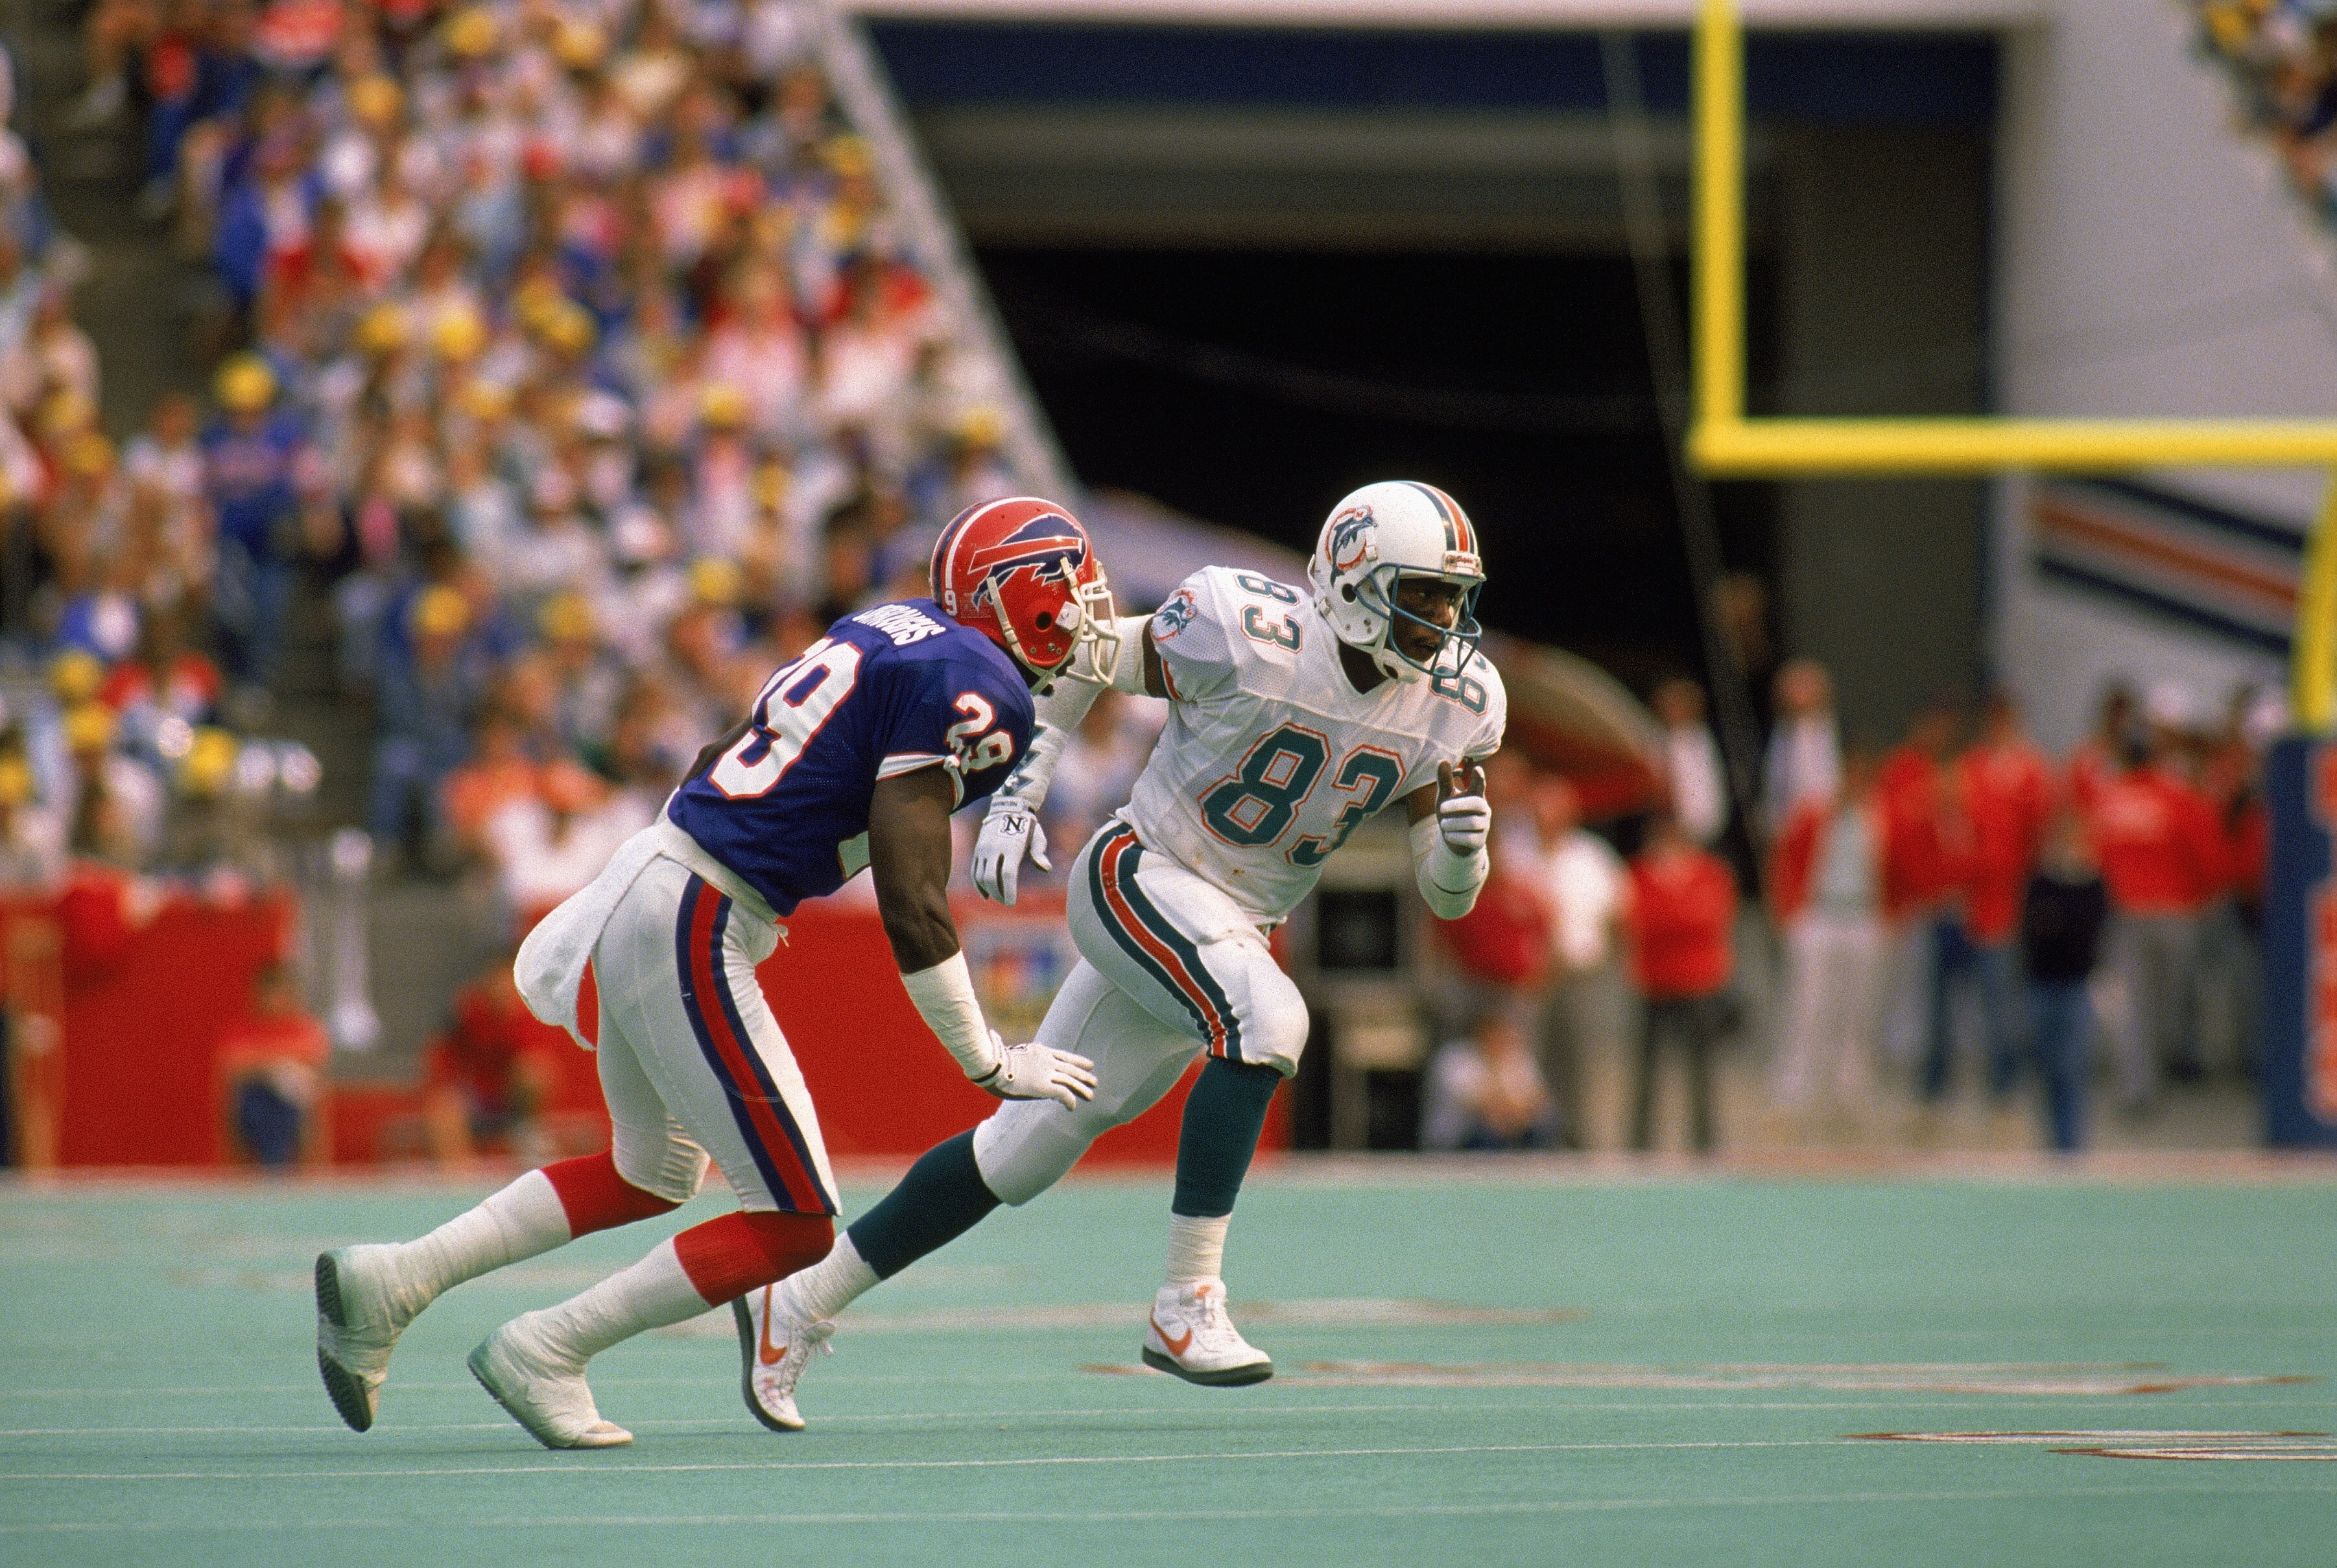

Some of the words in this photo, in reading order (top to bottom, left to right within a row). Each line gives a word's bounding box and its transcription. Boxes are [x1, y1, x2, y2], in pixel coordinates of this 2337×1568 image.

[1232, 573, 1303, 654] 83
[1428, 641, 1489, 717] 8
[943, 691, 1015, 776] 29
[1004, 816, 1023, 831] N
[1198, 721, 1406, 869] 83
